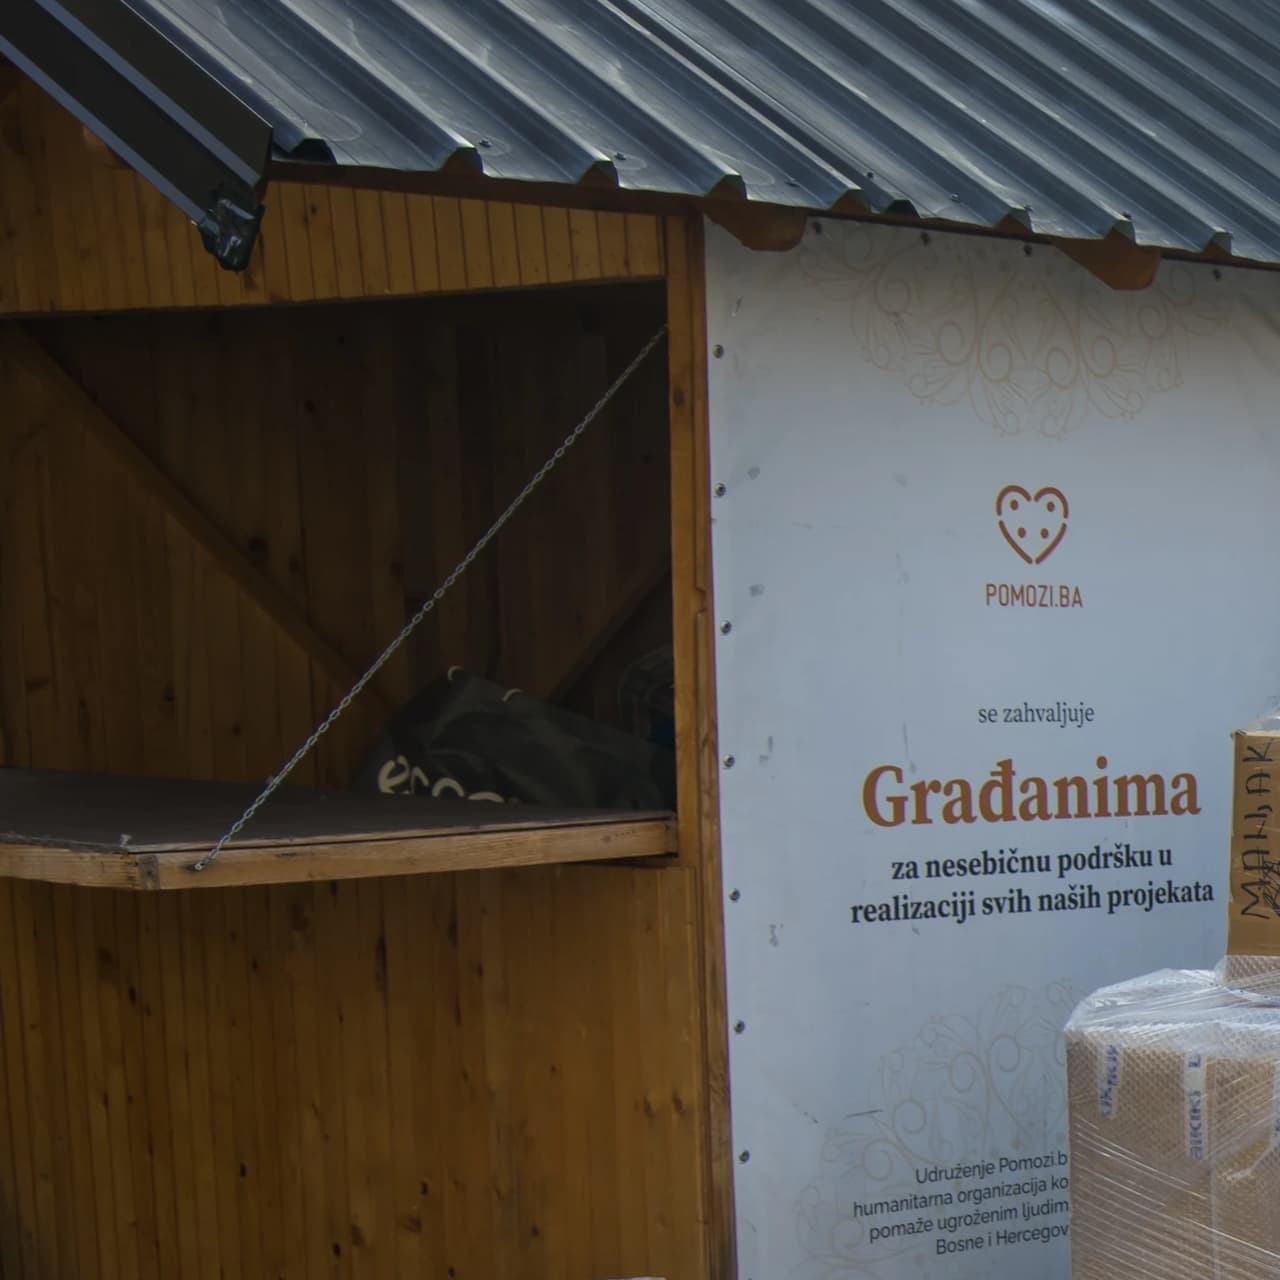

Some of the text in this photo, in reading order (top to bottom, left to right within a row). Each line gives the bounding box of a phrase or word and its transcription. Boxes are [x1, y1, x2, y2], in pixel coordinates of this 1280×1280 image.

[985, 583, 1083, 608] POMOZI.BA
[978, 701, 1095, 728] se zahvaljuje
[862, 757, 1201, 827] Građanima
[891, 843, 1172, 881] za nesebičnu podršku u
[851, 880, 1215, 924] realizaciji svih naših projekata
[915, 1162, 996, 1184] Udruženje
[853, 1193, 953, 1218] humanitarna
[957, 1181, 1047, 1206] organizacija
[869, 1217, 934, 1244] pomaže
[937, 1206, 1018, 1233] ugroženim
[936, 1223, 1070, 1255] Bosne i Hercegov
